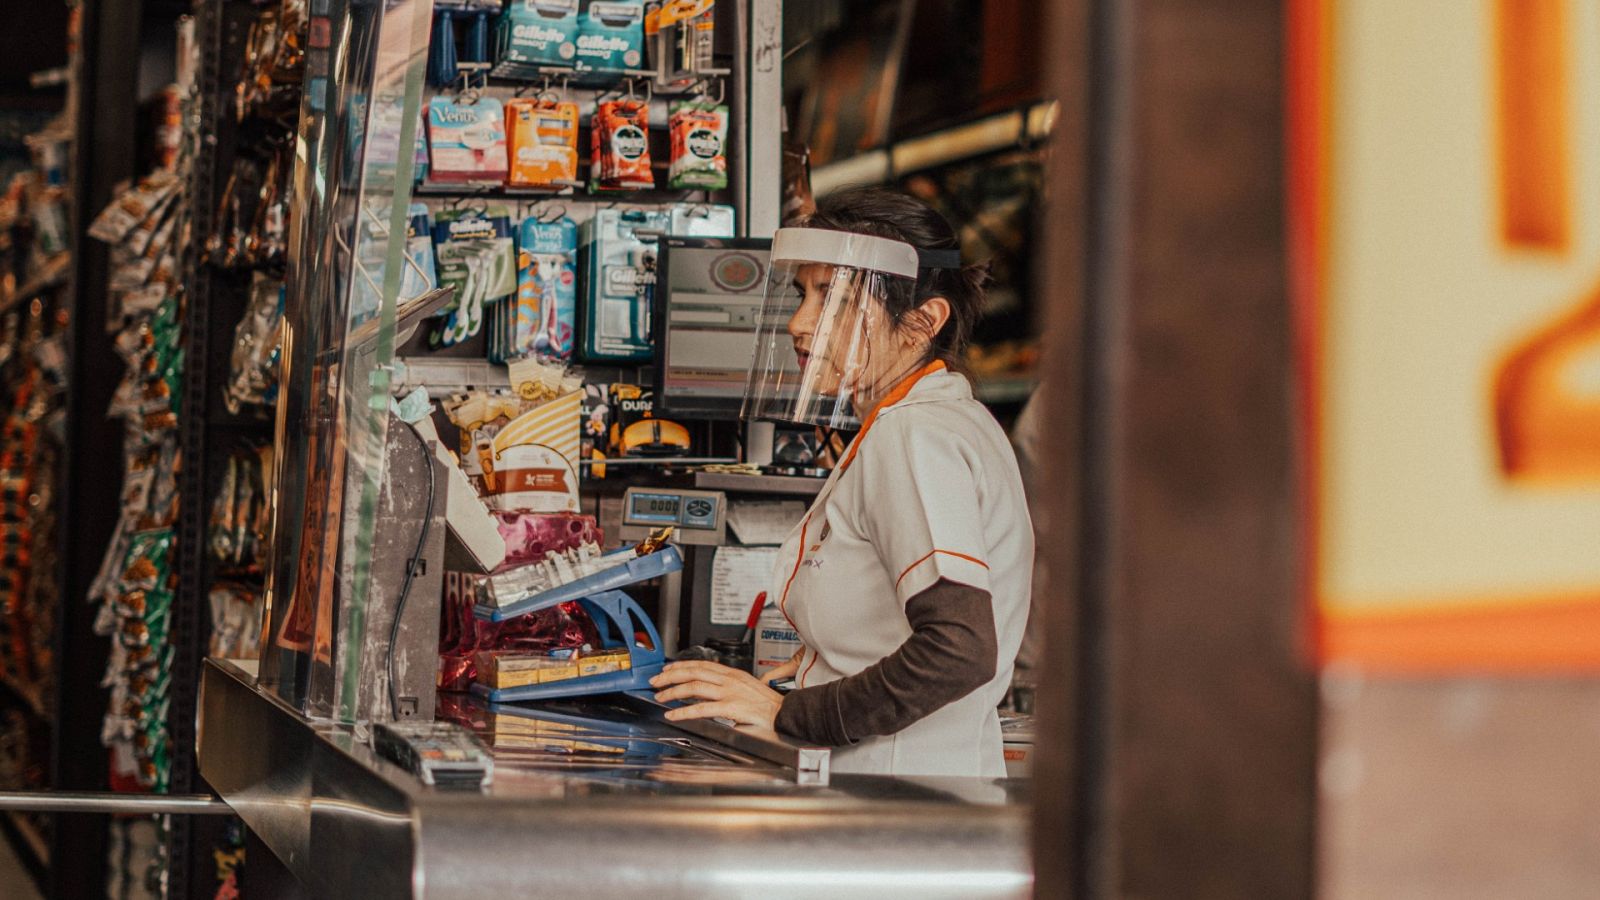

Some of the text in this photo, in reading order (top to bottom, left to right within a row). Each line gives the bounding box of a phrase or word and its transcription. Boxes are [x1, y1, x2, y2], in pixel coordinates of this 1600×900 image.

[513, 24, 566, 42] Gillette
[576, 35, 629, 51] Gillette
[433, 105, 478, 122] Venus
[449, 219, 493, 233] Gillette
[611, 270, 656, 284] Gillett
